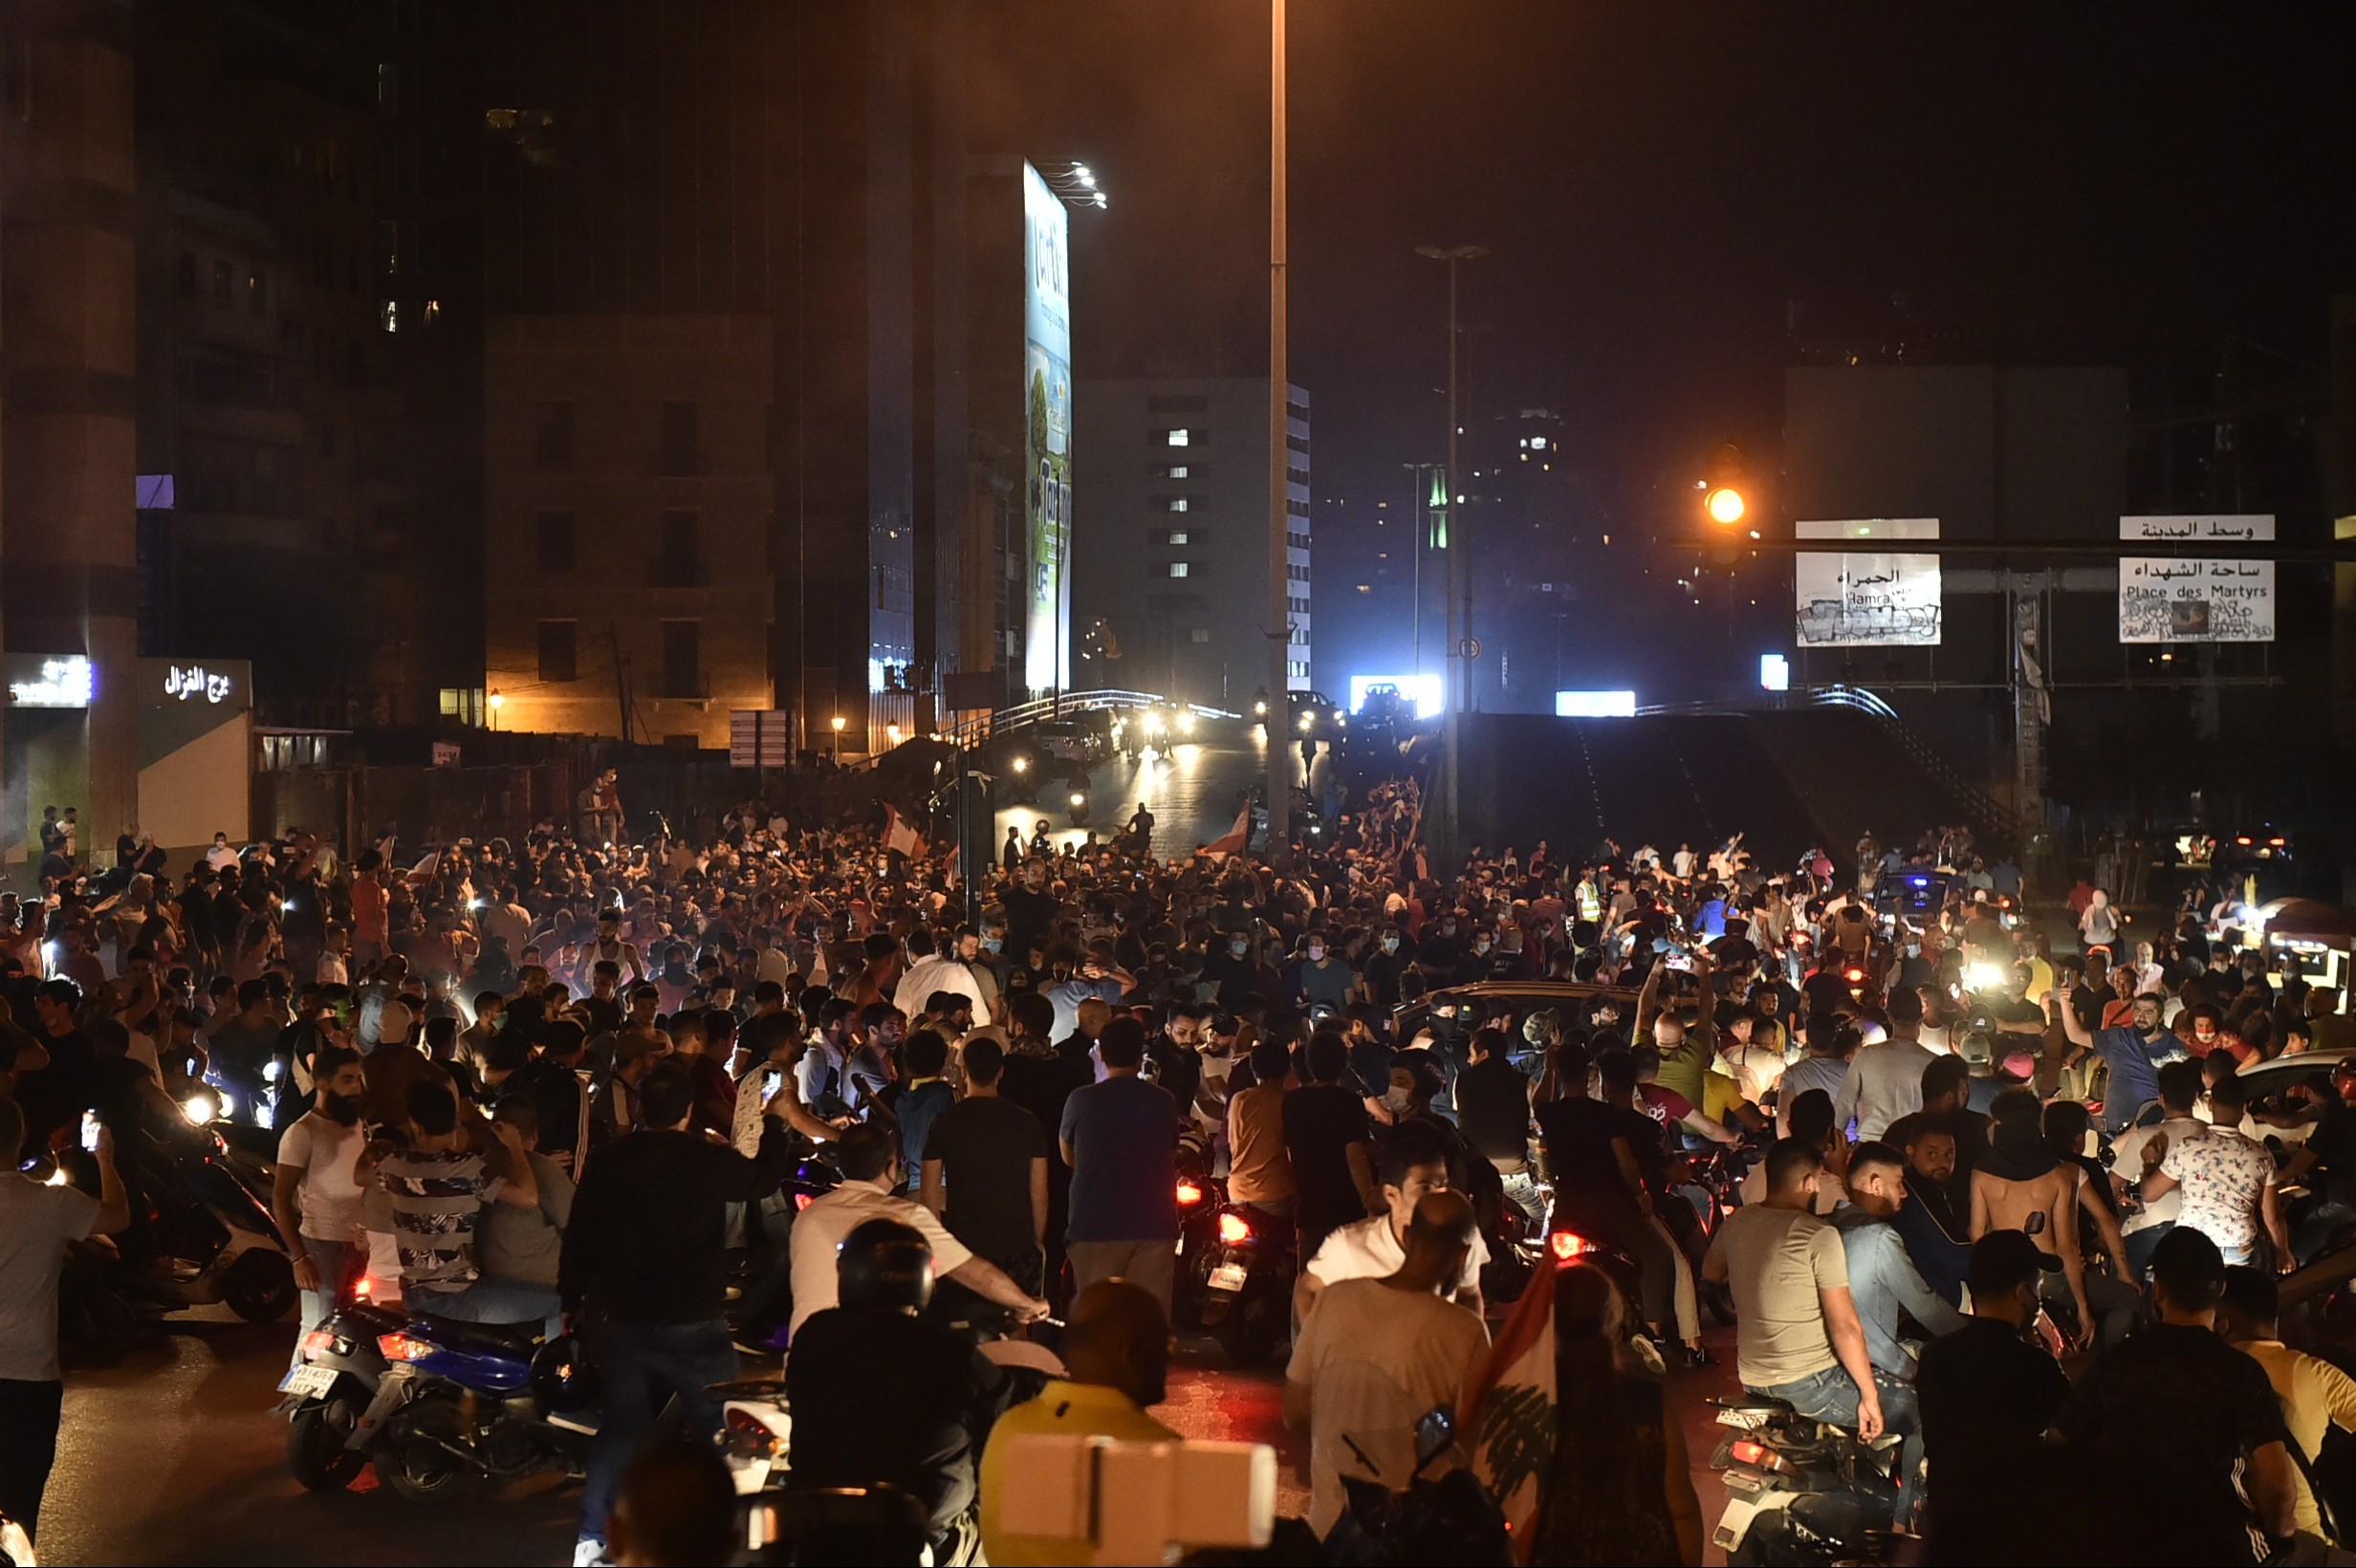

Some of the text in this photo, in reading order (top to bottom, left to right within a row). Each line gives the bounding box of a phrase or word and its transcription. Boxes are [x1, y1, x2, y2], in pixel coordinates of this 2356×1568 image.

[2142, 521, 2254, 539] وسط المدينة
[1837, 569, 1900, 588] الحمراء
[2134, 561, 2259, 580] ساحة الشهداء
[1846, 593, 1890, 605] Hamra
[2127, 585, 2267, 599] Place des Martyrs
[164, 664, 229, 704] برج الغزال
